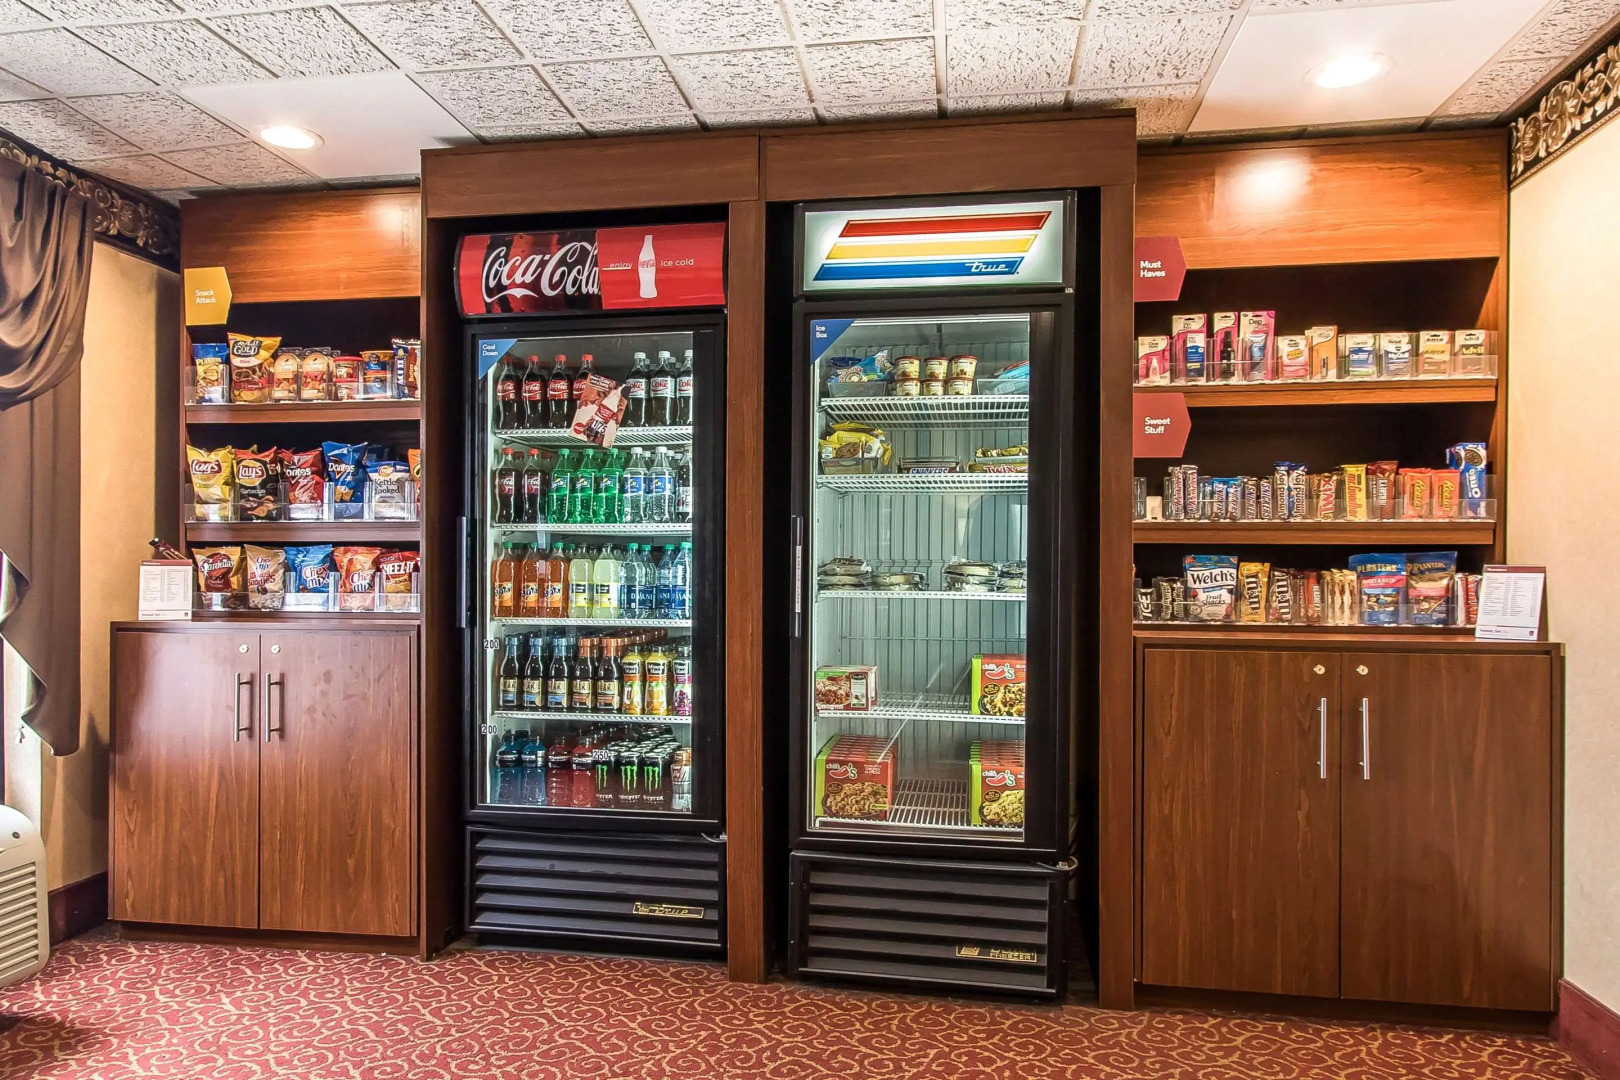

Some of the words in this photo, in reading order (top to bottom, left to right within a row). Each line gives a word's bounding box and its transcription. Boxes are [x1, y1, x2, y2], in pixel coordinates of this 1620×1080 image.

[609, 261, 632, 270] enjoy
[660, 258, 674, 267] ice
[675, 258, 694, 266] cold
[965, 262, 1010, 272] true
[1140, 260, 1162, 269] Must
[481, 241, 601, 303] Coca-Cola
[1140, 270, 1166, 278] Haves
[195, 289, 214, 297] Snack
[234, 346, 258, 355] GOLD
[1462, 346, 1484, 354] Advil
[1144, 417, 1170, 425] Sweet
[1144, 426, 1164, 434] Stuff
[328, 462, 355, 473] Doritos
[374, 478, 396, 486] Kettle
[1278, 471, 1286, 486] Joy
[1294, 472, 1302, 486] Joy
[1469, 468, 1482, 498] OREO
[1262, 484, 1271, 518] SNICKERS
[1279, 487, 1287, 518] Almond
[303, 563, 330, 579] Chex
[1357, 564, 1397, 572] PLANTERS
[307, 576, 329, 588] mix
[1190, 570, 1235, 585] Welch's
[352, 582, 374, 592] mix
[1138, 594, 1152, 617] ICE
[484, 640, 499, 649] 200
[481, 725, 497, 734] 200
[593, 750, 608, 760] 250
